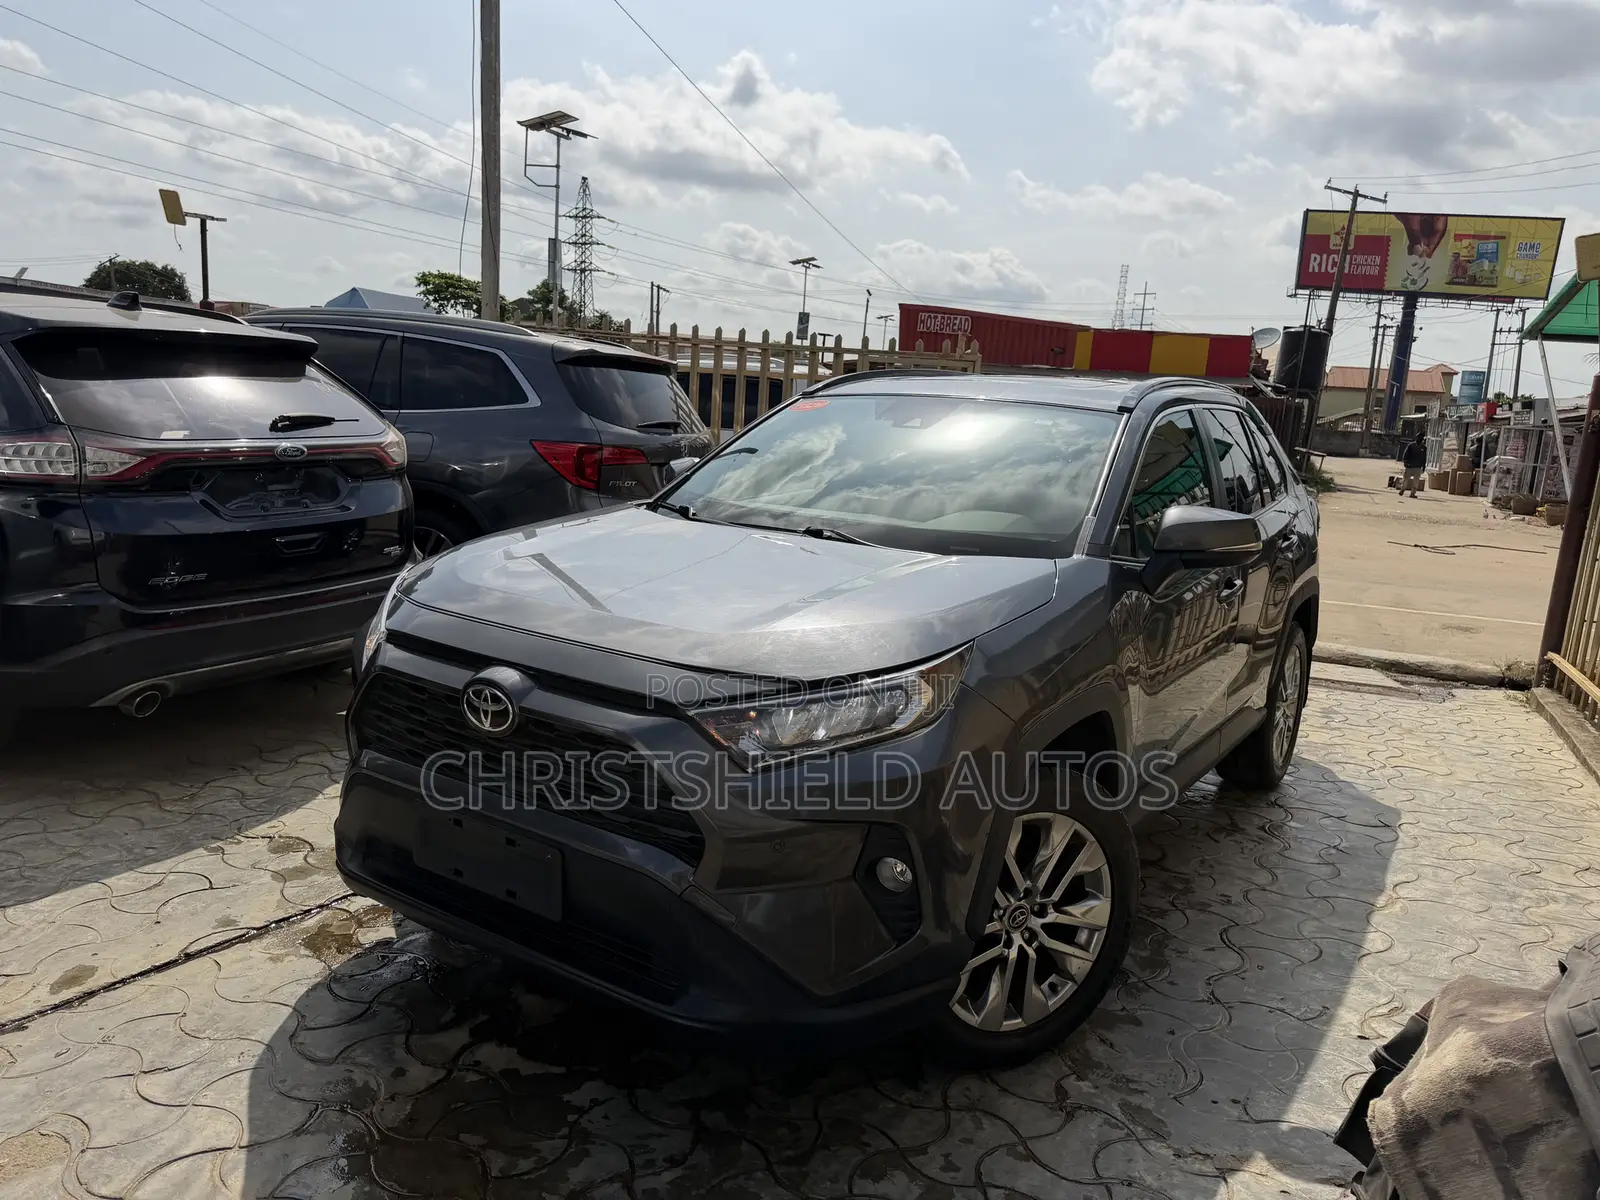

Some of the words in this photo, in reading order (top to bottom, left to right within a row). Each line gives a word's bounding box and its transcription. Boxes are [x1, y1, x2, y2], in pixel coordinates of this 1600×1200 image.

[1351, 254, 1381, 266] CHICKEN
[1350, 265, 1380, 275] FLAVOUR
[148, 573, 208, 585] EDGE
